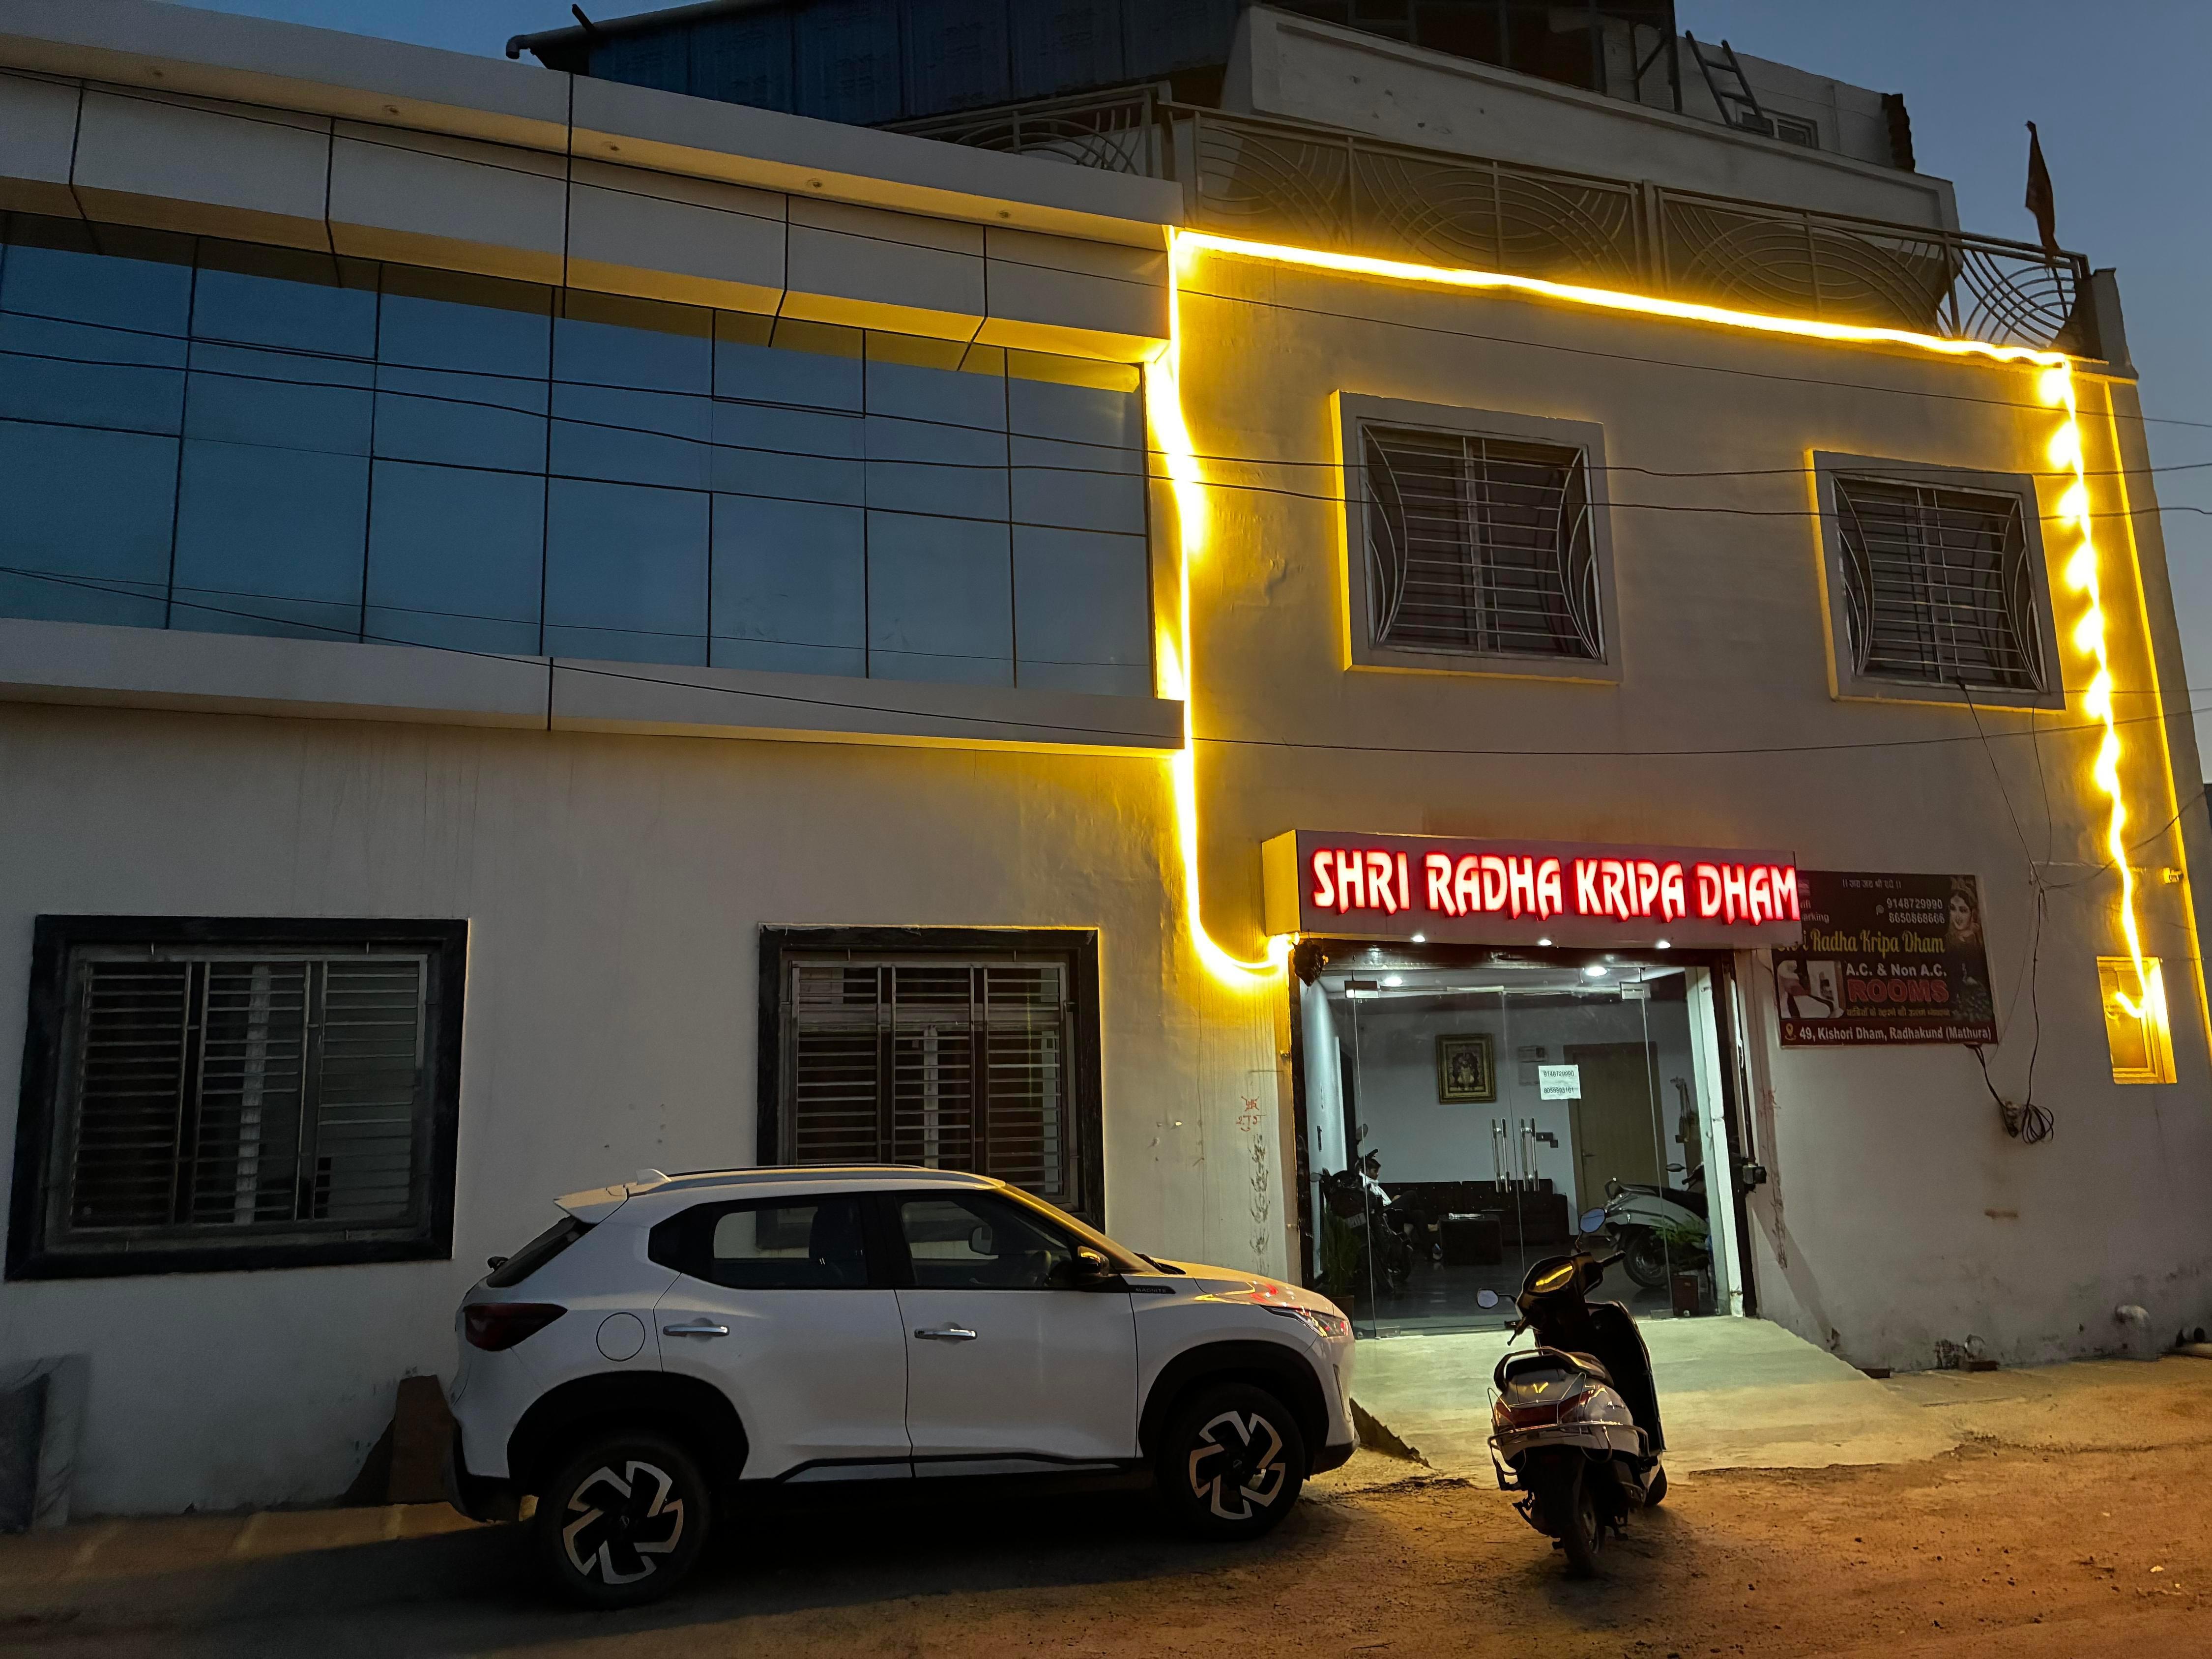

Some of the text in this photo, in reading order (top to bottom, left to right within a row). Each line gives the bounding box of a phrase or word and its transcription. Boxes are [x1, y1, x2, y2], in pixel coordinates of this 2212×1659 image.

[1311, 849, 1800, 926] SHRI RADHA KRIPA DHAM
[1887, 898, 1943, 909] 9148729990
[1802, 912, 1830, 924] arking
[1810, 928, 1858, 952] Radha
[1860, 930, 1900, 959] Kripa
[1902, 930, 1945, 954] Dham
[1846, 963, 1947, 977] A.C. & Non A.C.
[1847, 978, 1949, 1003] ROOMS
[1800, 1026, 1992, 1042] 49, Kishori Dham, Radhakund (Mathura)
